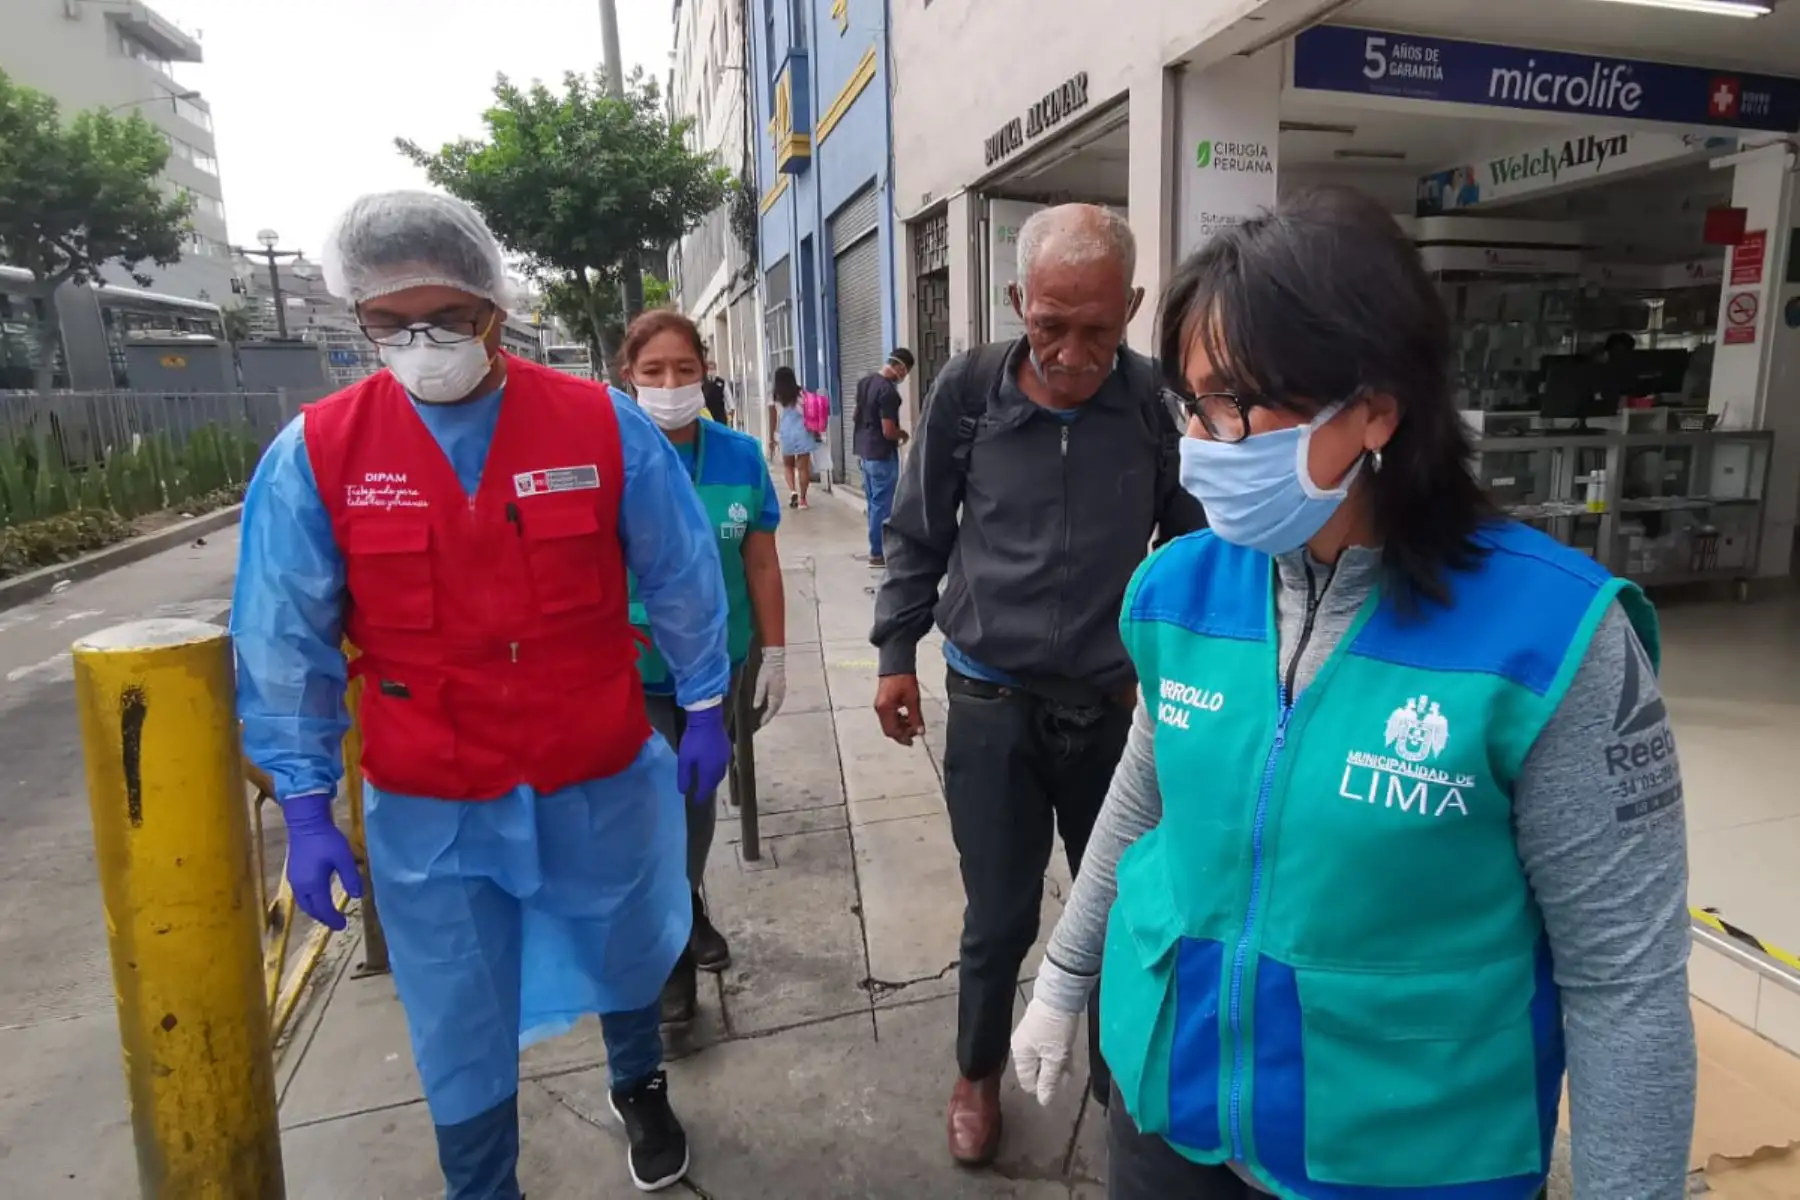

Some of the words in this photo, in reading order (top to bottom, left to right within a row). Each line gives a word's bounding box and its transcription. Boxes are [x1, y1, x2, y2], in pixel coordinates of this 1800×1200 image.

[1362, 36, 1387, 79] 5
[1392, 42, 1422, 61] AÑOS
[1424, 48, 1440, 62] DE
[1389, 61, 1444, 80] GARANTÍA
[1488, 58, 1643, 112] microlife
[1214, 156, 1274, 174] PERUANA
[364, 471, 407, 484] DIPAM
[1347, 749, 1449, 782] MUNICIPALIDAD
[1455, 773, 1476, 786] DE
[1339, 764, 1469, 817] LIMA
